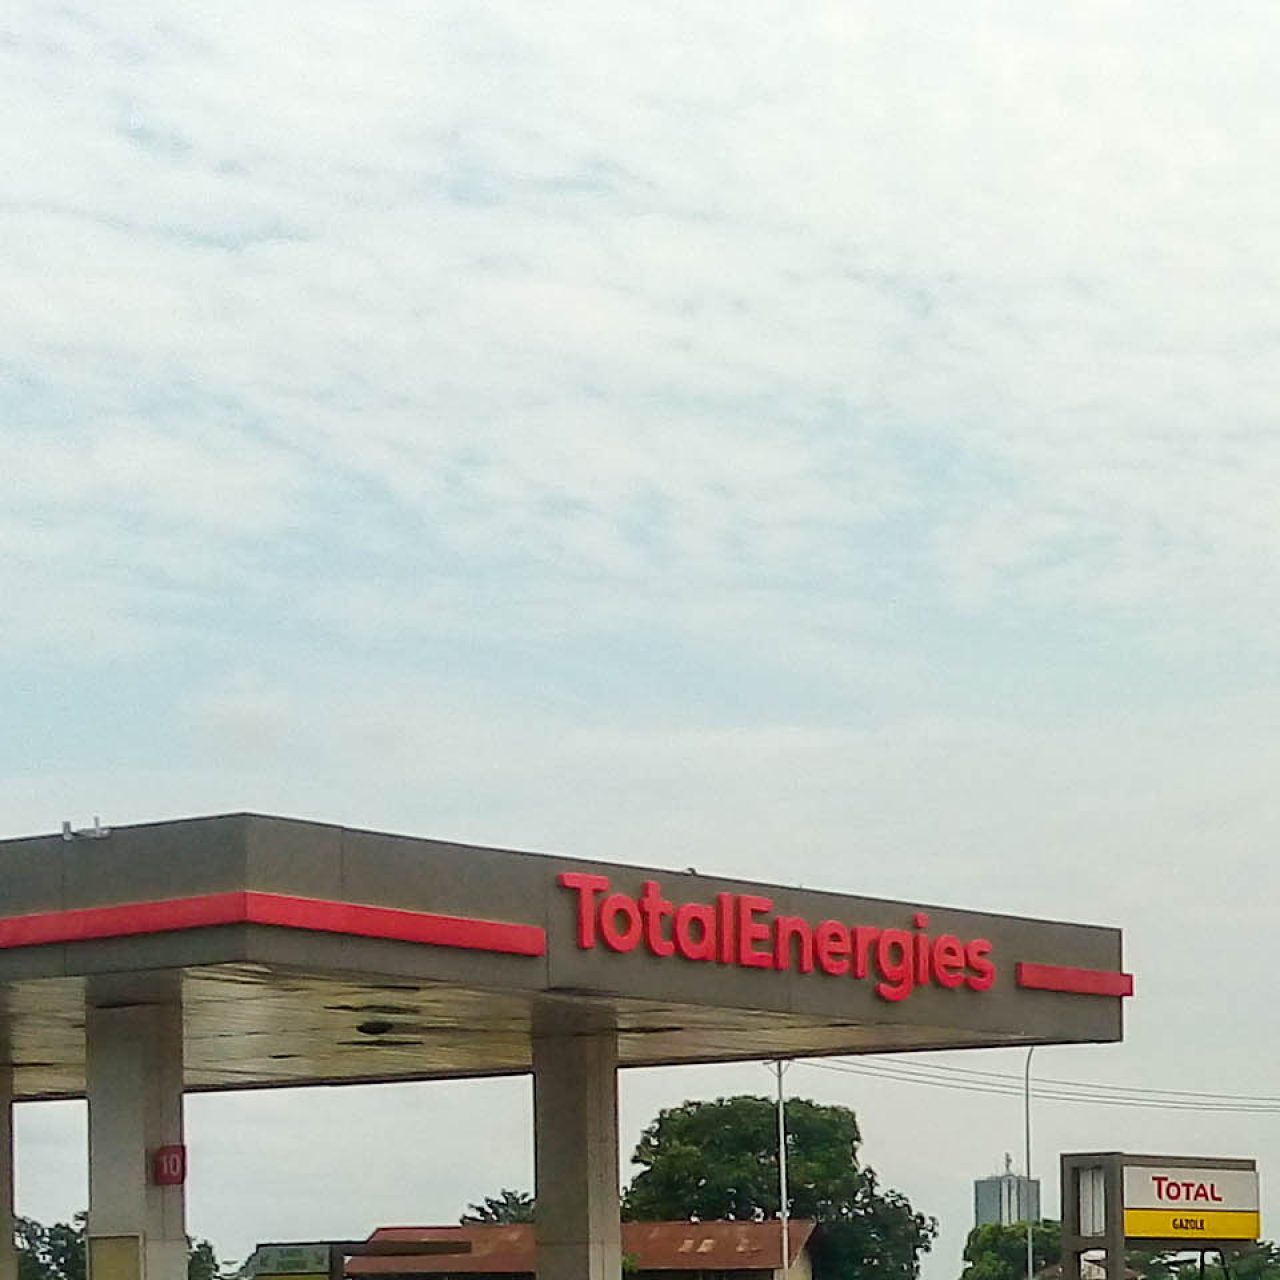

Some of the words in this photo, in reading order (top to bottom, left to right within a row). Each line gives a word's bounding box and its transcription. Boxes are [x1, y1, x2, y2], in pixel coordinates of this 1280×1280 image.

[558, 872, 996, 1001] TotalEnergies
[162, 1153, 182, 1177] 10
[1172, 1218, 1205, 1231] GAZOLE
